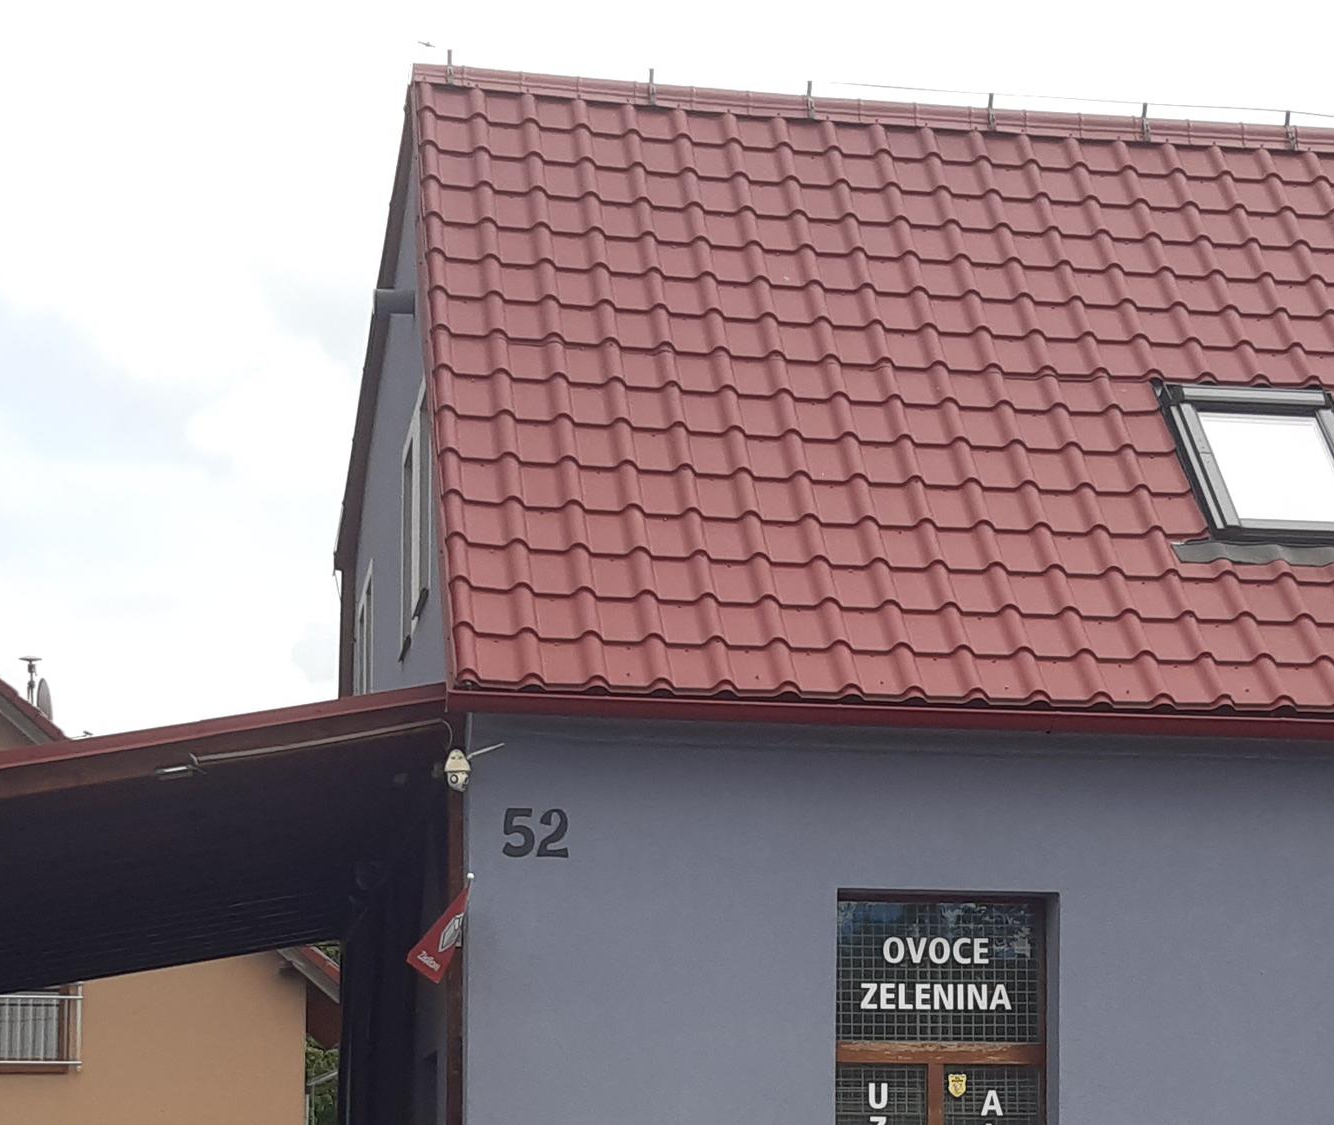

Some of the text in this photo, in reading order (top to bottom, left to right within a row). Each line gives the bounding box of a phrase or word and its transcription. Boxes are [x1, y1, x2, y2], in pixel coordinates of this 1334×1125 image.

[501, 807, 569, 859] 52
[882, 936, 990, 965] OVOCE
[859, 982, 1013, 1011] ZELENINA
